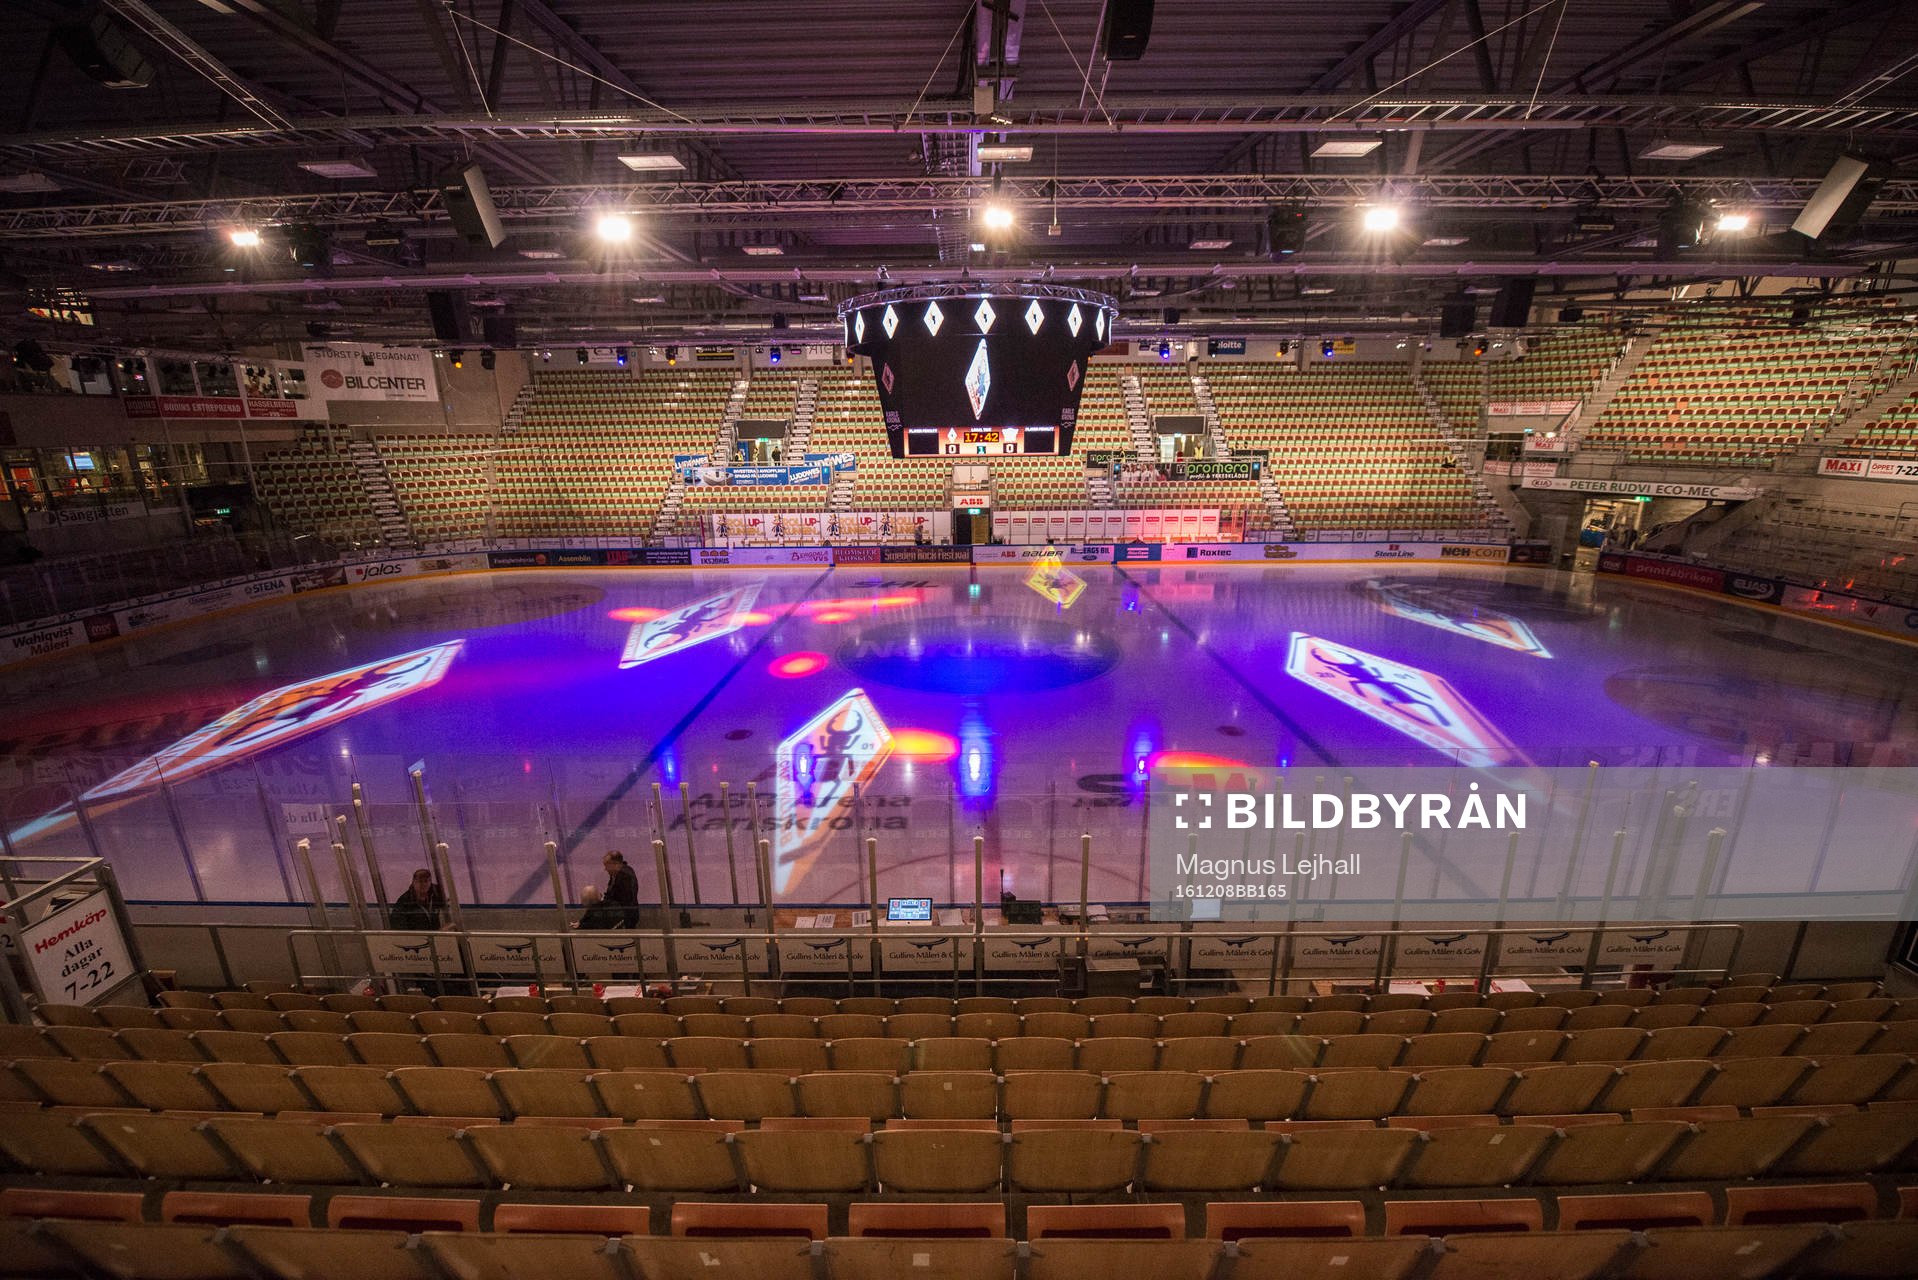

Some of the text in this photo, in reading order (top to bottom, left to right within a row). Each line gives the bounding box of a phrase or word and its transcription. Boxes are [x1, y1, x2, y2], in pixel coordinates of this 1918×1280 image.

[1213, 340, 1242, 348] eloitte
[345, 376, 426, 390] BILCENTER
[965, 432, 999, 442] 17:42
[949, 444, 956, 453] 0
[1006, 444, 1014, 453] 0
[1096, 453, 1136, 463] promra
[1187, 463, 1249, 475] promera
[1825, 459, 1862, 471] MAXI
[1895, 465, 1918, 476] 7-22
[1533, 480, 1550, 488] KIA
[1570, 481, 1607, 490] PETER
[1610, 483, 1651, 494] RUDVI
[1655, 486, 1720, 498] ECO-MEC
[1397, 550, 1415, 558] Line
[361, 563, 402, 581] jalas
[1636, 562, 1715, 584] printfabriken
[254, 579, 285, 593] STENA
[1733, 577, 1768, 595] ELIAS
[12, 626, 74, 649] Wahlqvist
[30, 637, 70, 656] Måleri
[34, 908, 108, 954] Hemköp
[64, 938, 94, 962] Alla
[1198, 948, 1224, 957] Gullins
[1302, 948, 1328, 956] Gullins
[1404, 948, 1430, 956] Gullins
[1507, 946, 1532, 954] Gullins
[1606, 945, 1631, 953] Gullins
[379, 953, 405, 962] Gullins
[480, 954, 506, 962] Gullins
[582, 954, 608, 962] Gullins
[683, 953, 709, 961] Gullins
[786, 952, 812, 961] Gullins
[847, 953, 864, 961] olv
[889, 952, 915, 960] Gullins
[992, 951, 1017, 959] Gullins
[61, 946, 104, 978] dagar
[64, 961, 115, 1001] 7-22
